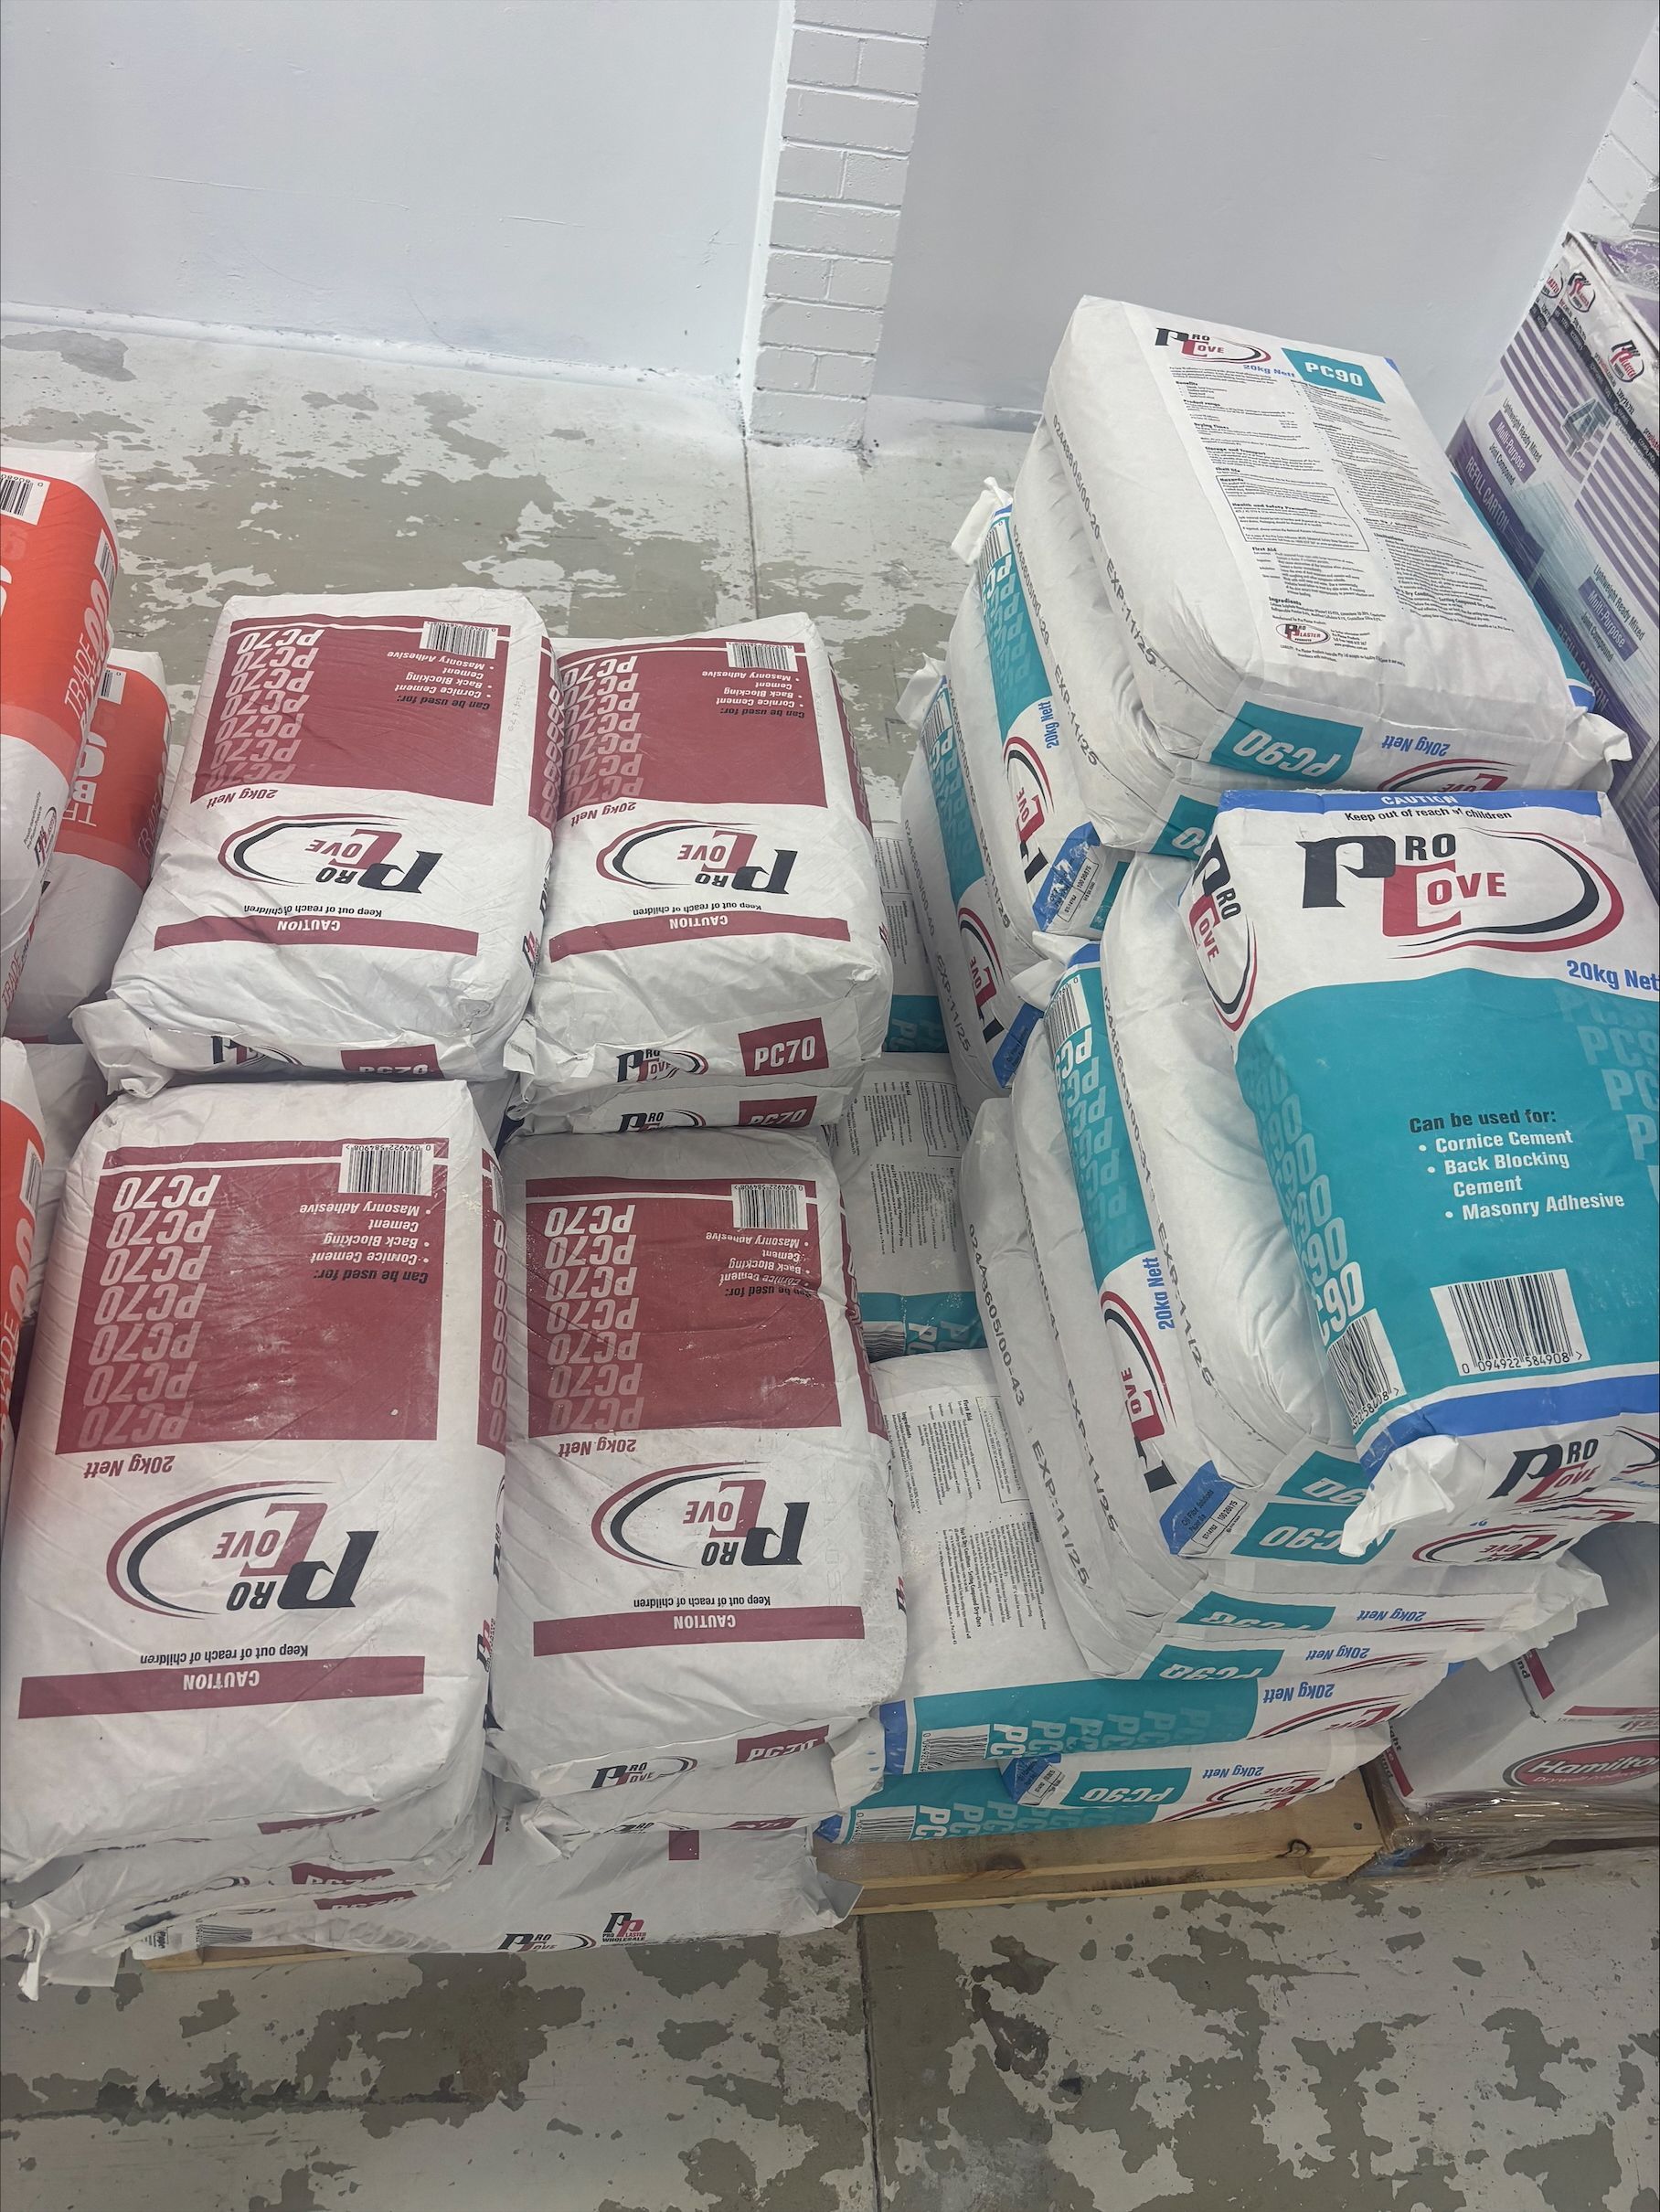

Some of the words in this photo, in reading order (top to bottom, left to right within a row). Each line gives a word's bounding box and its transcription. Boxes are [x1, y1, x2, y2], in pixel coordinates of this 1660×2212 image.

[1155, 327, 1210, 346] PRO
[1181, 340, 1225, 358] COVE
[1243, 365, 1272, 375] 20kg
[1273, 367, 1296, 378] Nett
[1304, 362, 1364, 387] PC90
[1495, 421, 1525, 472] Multi-Purpose
[1495, 455, 1516, 486] Compound
[1465, 456, 1486, 495] REFILL
[1483, 487, 1510, 533] CARTON
[1105, 557, 1157, 665] EXP:11/25
[1593, 565, 1618, 602] Lightweight
[1614, 597, 1631, 623] Ready
[1629, 616, 1645, 641] Mixed
[1587, 590, 1625, 648] Multi-Purpose
[239, 629, 325, 654] PC70
[1591, 626, 1614, 662] Compound
[231, 647, 319, 675] PC70
[563, 654, 638, 687] PC70
[226, 671, 314, 697] PC70
[563, 673, 639, 707] PC70
[220, 694, 310, 720] PC70
[564, 693, 640, 726] PC70
[1038, 699, 1053, 720] Nett
[564, 713, 640, 744] PC70
[1045, 720, 1059, 750] 20kg
[1382, 735, 1413, 753] Nett
[1413, 736, 1452, 757] 20kg
[1232, 728, 1342, 781] PC90
[206, 792, 238, 810] Nett
[239, 788, 279, 801] 20kg
[1380, 795, 1459, 806] CAUTION
[570, 808, 598, 828] Nett
[601, 801, 637, 815] 20kg
[1345, 813, 1376, 823] Keep
[1378, 810, 1399, 821] out
[1401, 808, 1412, 817] of
[1415, 808, 1450, 817] reach
[1464, 810, 1513, 819] children
[304, 828, 402, 868] COVE
[677, 830, 759, 874] COVE
[316, 849, 442, 895] PRO
[695, 849, 798, 895] PRO
[1295, 833, 1456, 909] PRO
[1382, 860, 1506, 938] COVE
[276, 920, 341, 931] CAUTION
[669, 916, 729, 929] CAUTION
[1566, 960, 1620, 991] 20kg
[1623, 969, 1660, 992] Net
[753, 1035, 816, 1071] PC70
[1410, 1116, 1446, 1133] Can
[1450, 1112, 1474, 1129] be
[1479, 1109, 1521, 1126] used
[1525, 1108, 1556, 1124] for:
[1435, 1133, 1504, 1154] Cornice
[1508, 1130, 1573, 1146] Cement
[1443, 1156, 1489, 1175] Back
[1494, 1152, 1570, 1171] Blocking
[112, 1174, 221, 1213] PC70
[1452, 1175, 1523, 1197] Cement
[299, 1199, 358, 1214] Adhesive
[364, 1201, 420, 1216] Masonry
[1462, 1199, 1539, 1220] Masonry
[1545, 1192, 1625, 1213] Adhesive
[106, 1208, 216, 1250] PC70
[368, 1219, 419, 1233] Cement
[545, 1204, 636, 1236] PC70
[323, 1232, 378, 1247] Blocking
[385, 1235, 419, 1248] Back
[755, 1234, 800, 1249] Masonry
[310, 1250, 360, 1263] Cement
[367, 1252, 418, 1266] Cornice
[545, 1234, 637, 1269] PC70
[762, 1249, 801, 1261] Cement
[99, 1245, 210, 1286] PC70
[728, 1258, 775, 1271] Blocking
[777, 1263, 802, 1274] Back
[1143, 1256, 1162, 1289] Nett
[314, 1269, 340, 1281] for:
[344, 1269, 377, 1281] used
[381, 1271, 399, 1283] be
[404, 1271, 429, 1283] Can
[545, 1267, 638, 1302] PC70
[726, 1287, 745, 1298] for:
[750, 1285, 775, 1294] used
[779, 1287, 790, 1296] be
[93, 1282, 208, 1325] PC70
[1157, 1221, 1215, 1388] EXP:11/25
[546, 1298, 640, 1333] PC70
[88, 1321, 203, 1366] PC70
[548, 1331, 642, 1366] PC70
[1463, 1362, 1470, 1375] 0
[1477, 1356, 1521, 1372] 094922
[1525, 1351, 1570, 1367] 584908
[82, 1361, 198, 1407] PC70
[548, 1363, 644, 1398] PC70
[1120, 1366, 1166, 1441] COVE
[550, 1397, 644, 1431] PC70
[79, 1402, 194, 1448] PC70
[559, 1441, 591, 1457] Nett
[596, 1439, 636, 1453] 20kg
[84, 1459, 122, 1479] Nett
[127, 1455, 176, 1473] 20kg
[1487, 1439, 1599, 1499] PRO
[683, 1479, 767, 1538] COVE
[212, 1502, 329, 1577] COVE
[700, 1502, 810, 1566] PRO
[226, 1530, 379, 1611] PRO
[633, 1598, 674, 1609] children
[676, 1598, 686, 1607] of
[689, 1598, 715, 1607] reach
[718, 1598, 728, 1607] of
[729, 1597, 744, 1607] out
[748, 1594, 771, 1605] Keep
[673, 1614, 737, 1629] CAUTION
[1357, 1610, 1389, 1622] Nett
[1388, 1608, 1427, 1622] 20kg
[139, 1653, 186, 1665] children
[190, 1653, 201, 1664] of
[205, 1648, 237, 1662] reach
[239, 1648, 252, 1661] of
[256, 1646, 276, 1657] out
[280, 1643, 309, 1657] Keep
[1305, 1649, 1334, 1661] Nett
[1336, 1645, 1371, 1658] 20kg
[183, 1671, 261, 1691] CAUTION
[1298, 1682, 1335, 1698] 20kg
[1263, 1689, 1294, 1704] Nett
[591, 1762, 647, 1789] PRO
[1203, 1768, 1230, 1780] Nett
[1234, 1765, 1265, 1777] 20kg
[1080, 1786, 1176, 1803] PC90
[497, 1933, 552, 1951] PRO
